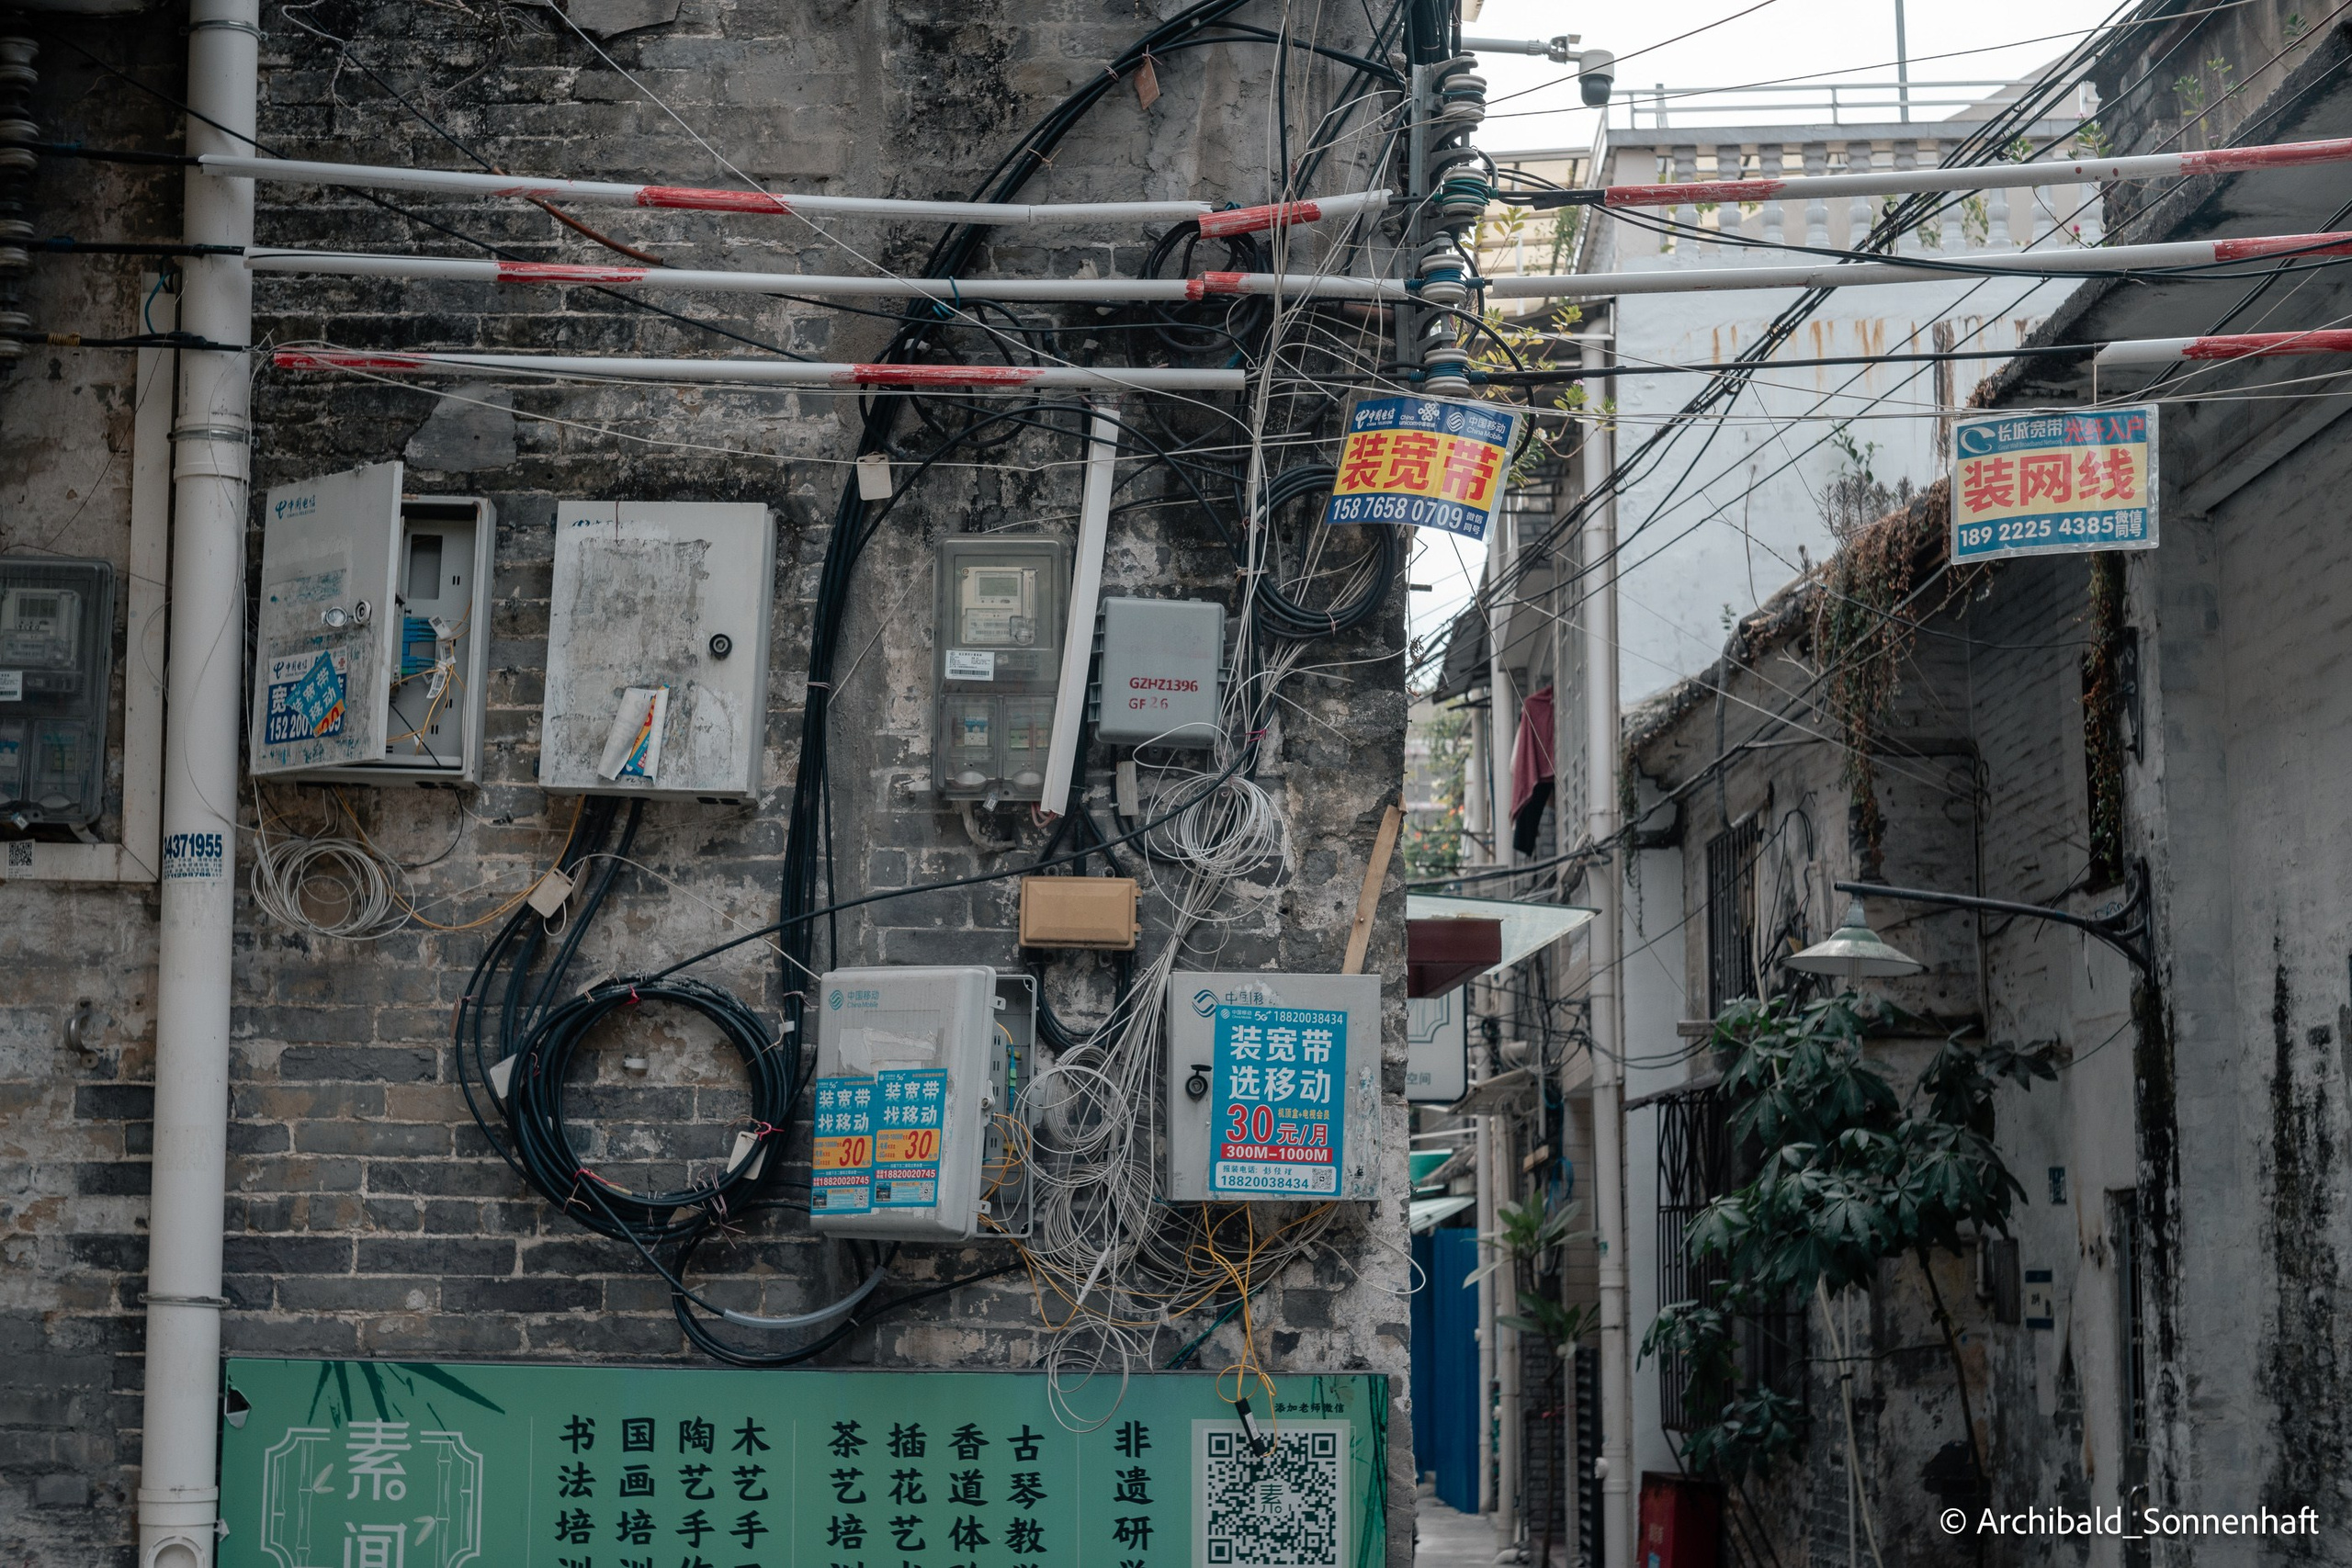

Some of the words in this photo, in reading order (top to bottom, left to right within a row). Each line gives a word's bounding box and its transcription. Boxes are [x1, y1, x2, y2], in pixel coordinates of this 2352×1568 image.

[1467, 426, 1484, 435] China
[1484, 431, 1503, 441] Mobile
[1469, 416, 1506, 434] 中国移动
[1998, 418, 2063, 442] 长城宽带
[2064, 415, 2144, 443] 光纤入户
[1341, 433, 1498, 502] 装宽带
[1963, 448, 2135, 513] 装网线
[1333, 499, 1360, 521] 158
[1363, 497, 1408, 519] 7658
[1411, 500, 1463, 529] 0709
[1466, 512, 1484, 525] 微信
[2115, 510, 2143, 525] 微信
[1463, 523, 1480, 535] 同号
[1961, 526, 1992, 547] 189
[1998, 520, 2052, 541] 2225
[2058, 516, 2113, 536] 4385
[2115, 524, 2143, 538] 同号
[1129, 677, 1198, 693] GZHZ1396
[1128, 697, 1147, 710] GF
[270, 716, 288, 741] 152
[1226, 991, 1278, 1005] 中国移
[1254, 1011, 1268, 1021] 5G
[1274, 1011, 1343, 1024] 18820038434
[1230, 1024, 1333, 1064] 装宽带
[885, 1080, 939, 1102] 装宽带
[1228, 1066, 1331, 1103] 选移动
[819, 1089, 871, 1110] 装宽带
[818, 1112, 869, 1133] 找移动
[884, 1105, 937, 1126] 找移动
[1226, 1103, 1274, 1144] 30
[1276, 1122, 1329, 1146] 元/月
[839, 1138, 865, 1167] 30
[905, 1131, 933, 1159] 30
[1227, 1145, 1328, 1161] 300M-1000M
[820, 1177, 870, 1186] 18820020745
[884, 1169, 936, 1179] 18820020745
[1221, 1176, 1309, 1189] 18820038434
[1274, 1402, 1344, 1414] 添加老师微信
[554, 1415, 597, 1568] 书法培
[616, 1417, 657, 1568] 国画培
[675, 1416, 716, 1568] 陶艺手
[729, 1416, 771, 1568] 木艺手
[826, 1420, 868, 1568] 茶艺培
[887, 1422, 927, 1568] 插花艺
[947, 1423, 990, 1568] 香道体
[1004, 1424, 1047, 1568] 古琴教
[1112, 1420, 1155, 1568] 非遗研
